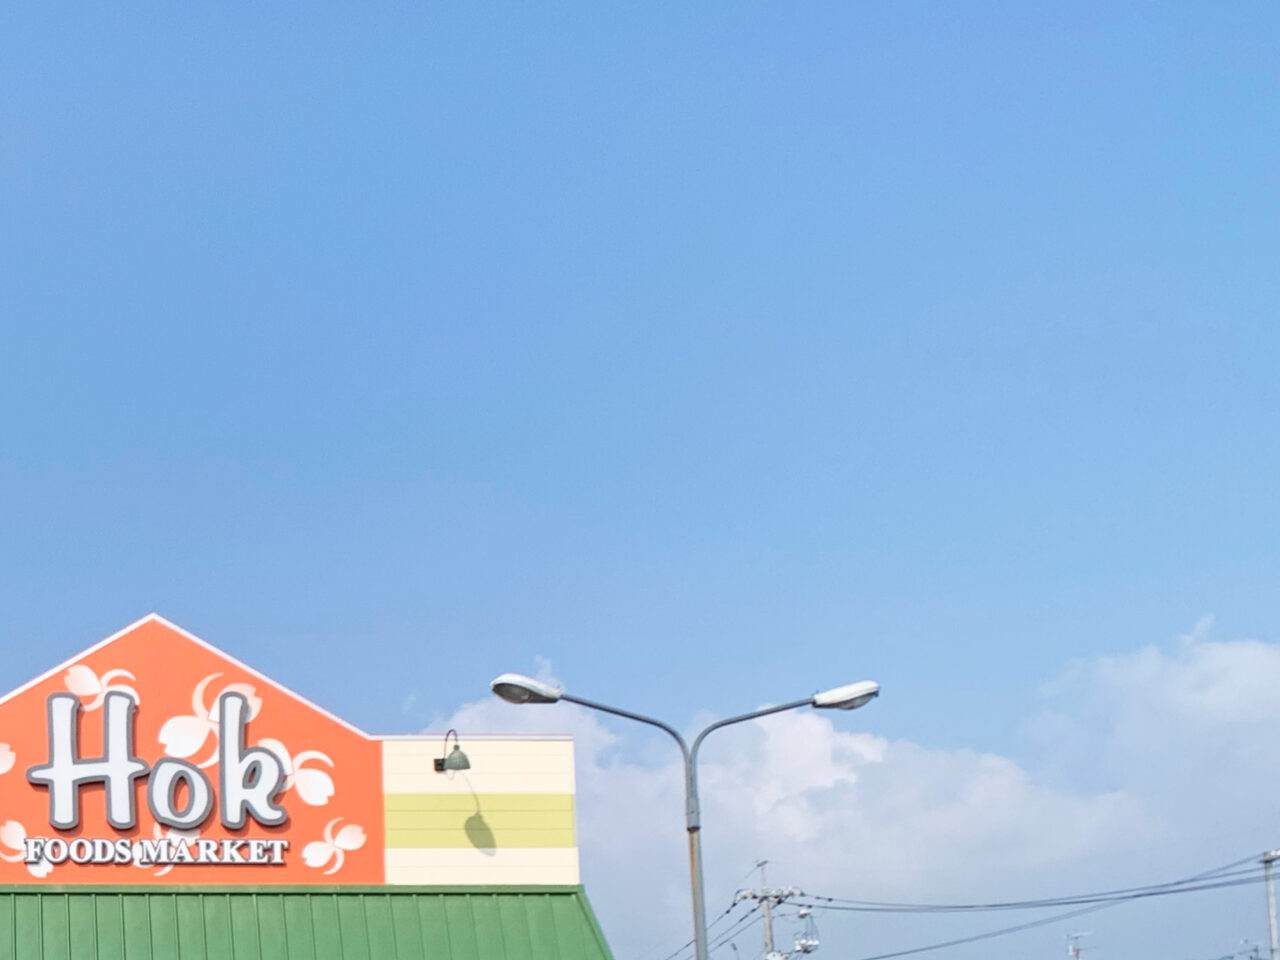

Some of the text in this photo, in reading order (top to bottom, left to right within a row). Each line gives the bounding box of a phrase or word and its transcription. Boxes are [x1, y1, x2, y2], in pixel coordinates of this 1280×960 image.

[26, 691, 287, 830] Hok
[24, 838, 288, 864] FOODS MARKET
